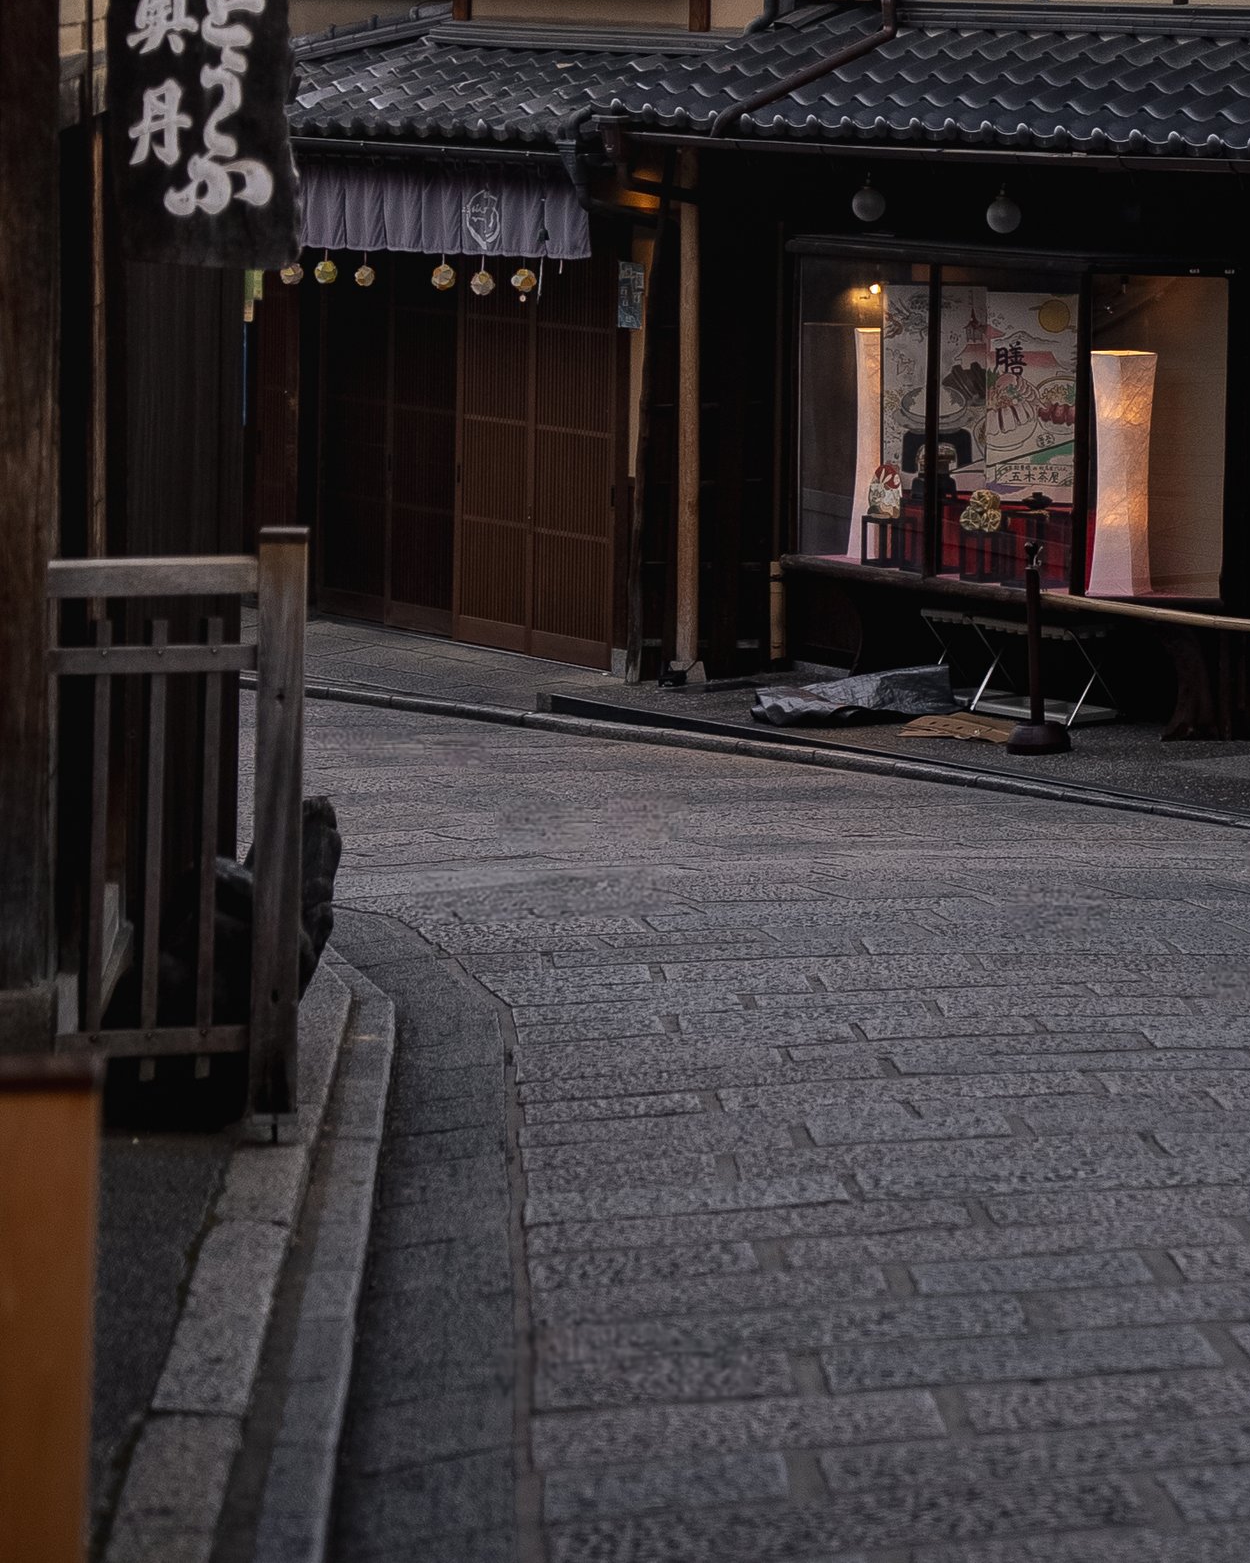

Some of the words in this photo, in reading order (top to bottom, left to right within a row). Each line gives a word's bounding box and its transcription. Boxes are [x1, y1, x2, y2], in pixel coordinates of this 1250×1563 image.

[995, 340, 1027, 376] 膳
[1008, 470, 1059, 484] 五木茶屋
